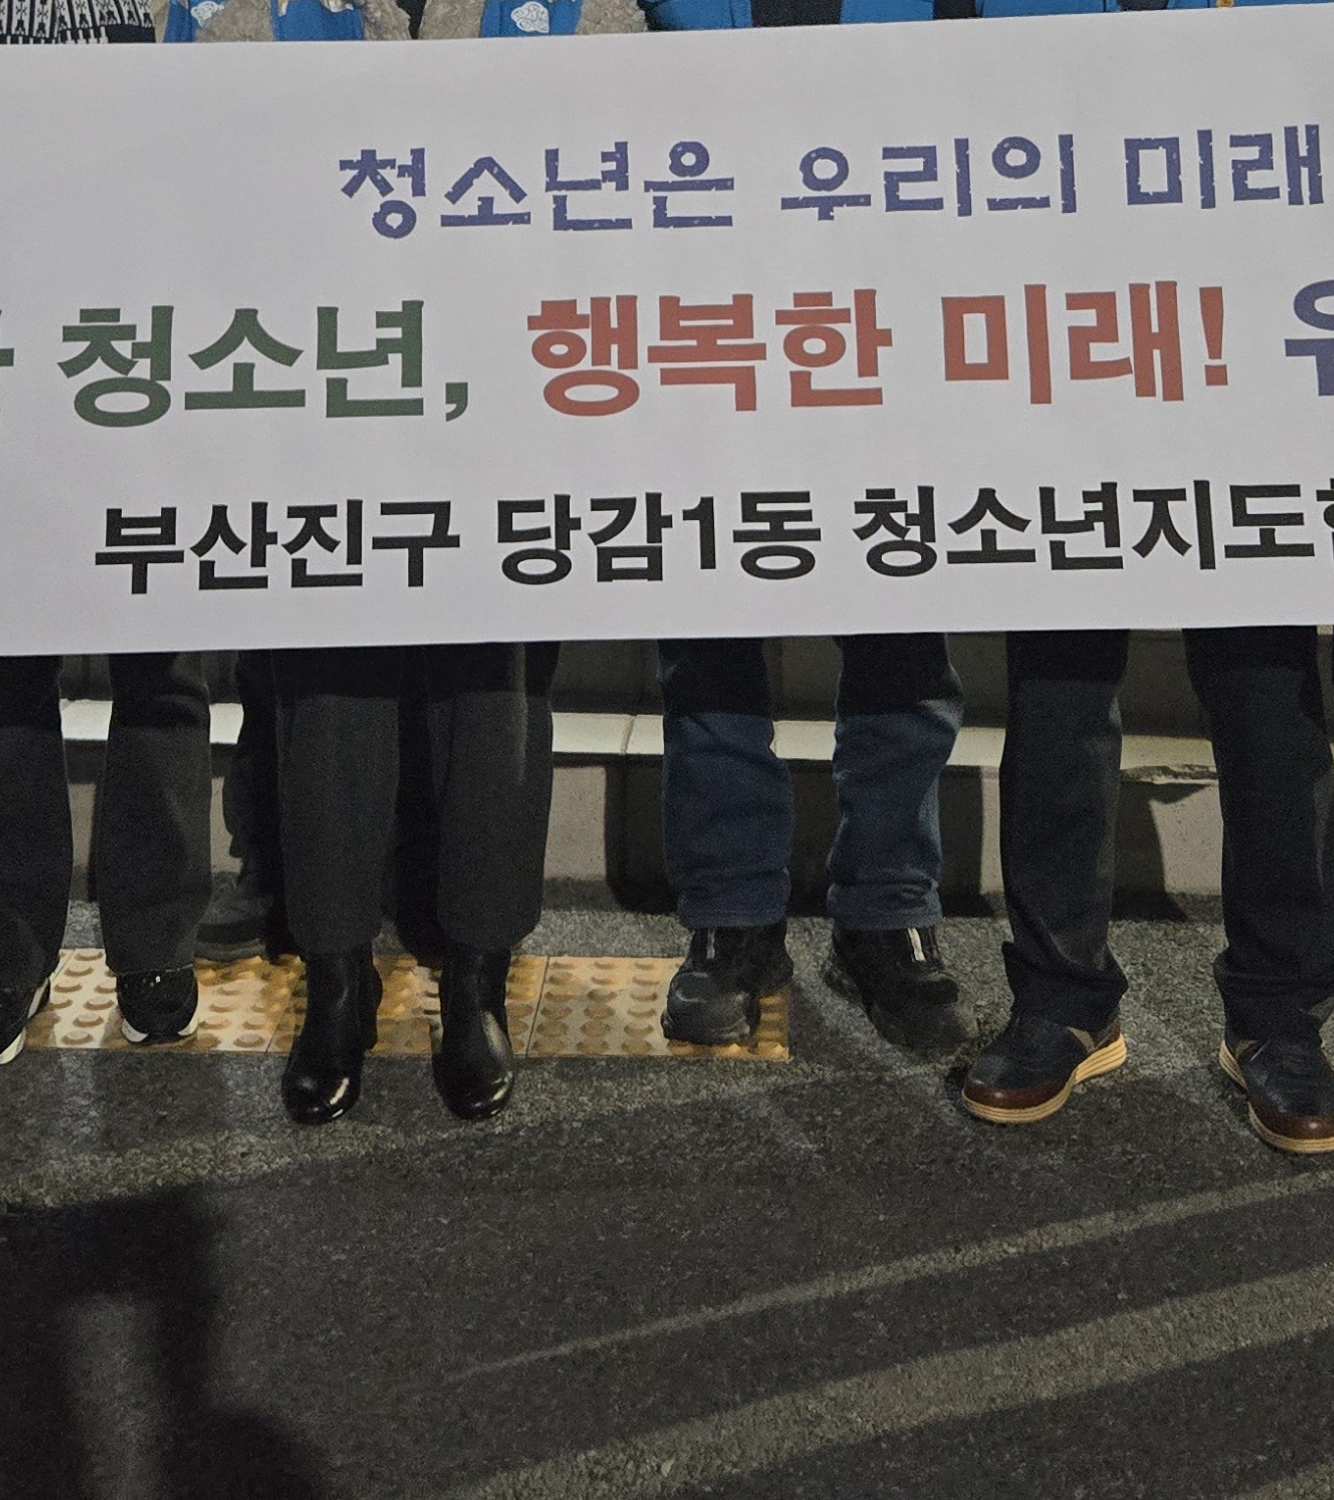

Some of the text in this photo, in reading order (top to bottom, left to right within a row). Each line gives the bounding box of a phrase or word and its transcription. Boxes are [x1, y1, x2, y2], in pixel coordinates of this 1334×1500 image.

[337, 123, 1325, 239] 청소년은 우리의 미래
[56, 300, 469, 428] 청소년,
[526, 287, 893, 419] 행복한
[940, 279, 1229, 407] 미래!
[93, 496, 461, 595] 부산진구
[495, 490, 822, 582] 당감1동
